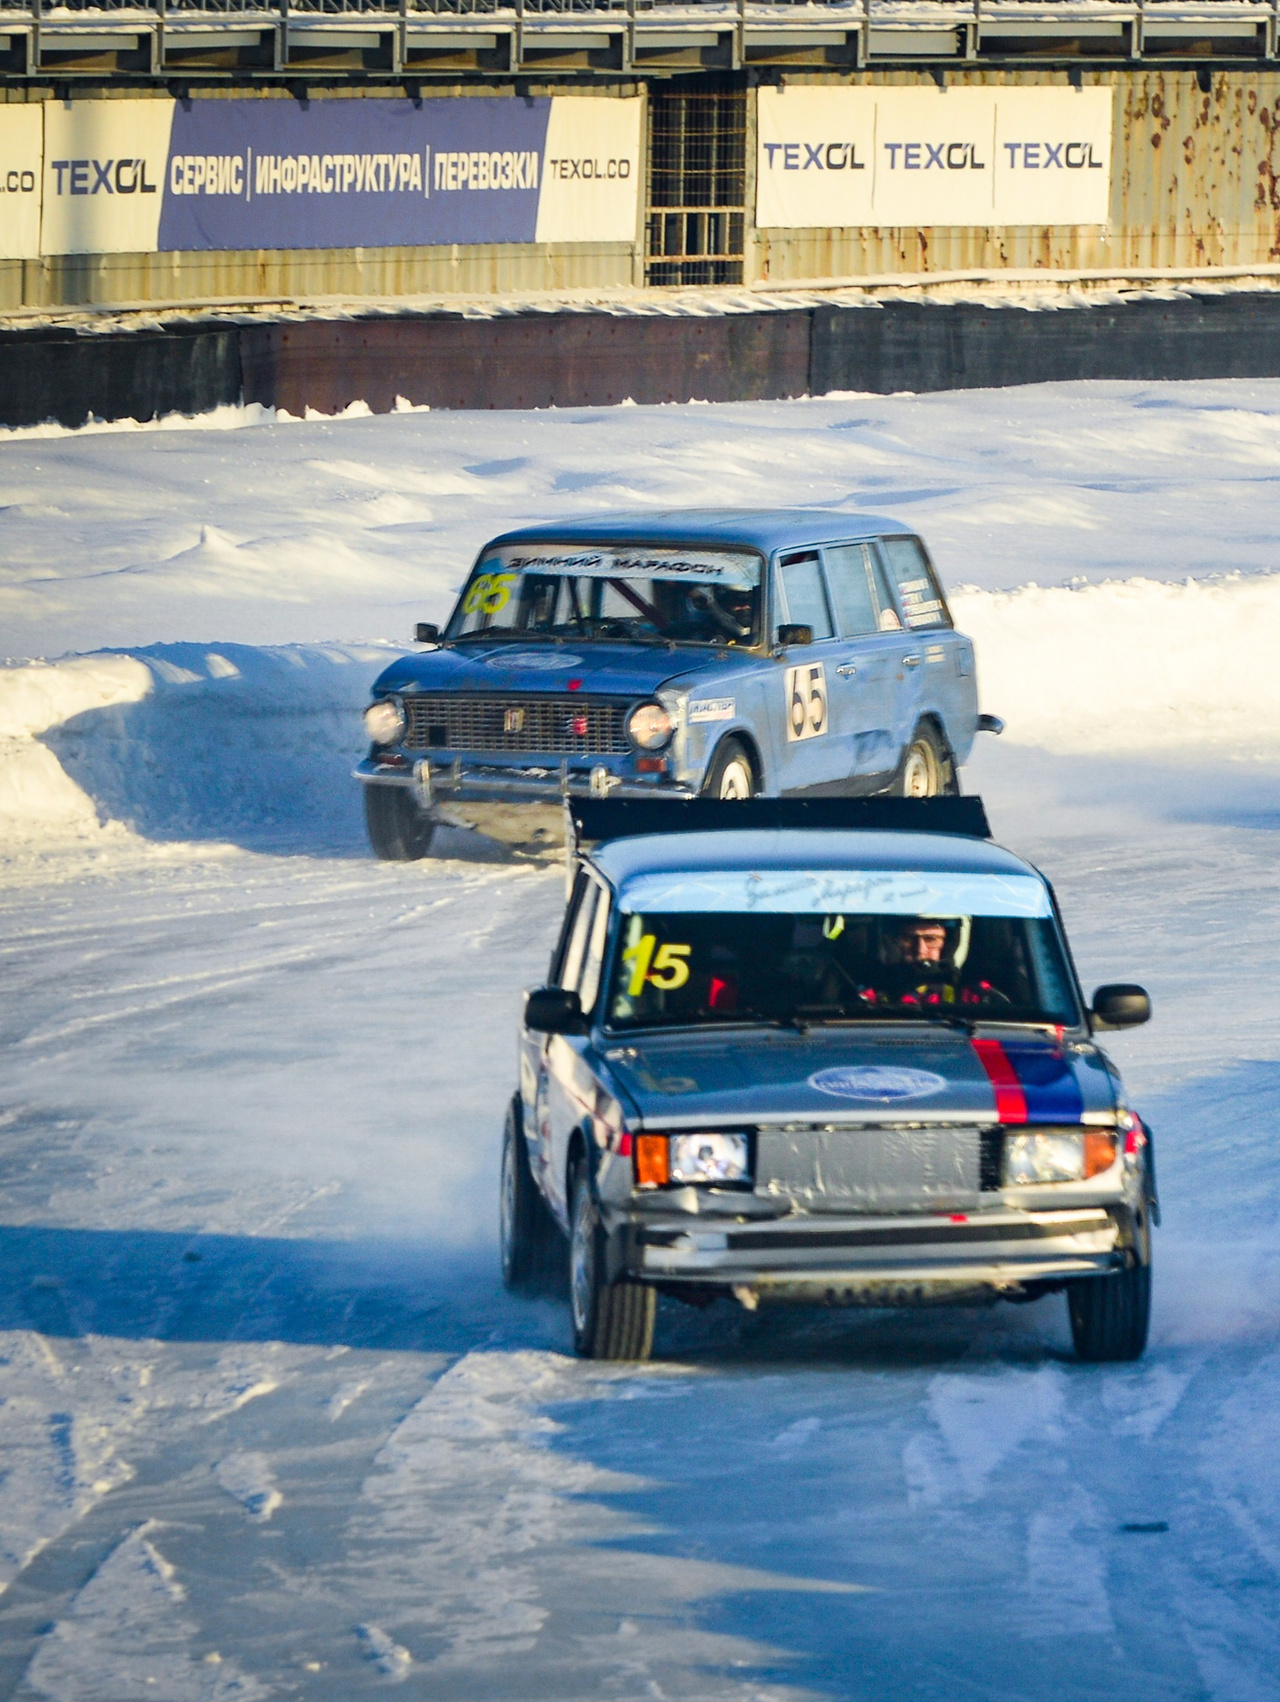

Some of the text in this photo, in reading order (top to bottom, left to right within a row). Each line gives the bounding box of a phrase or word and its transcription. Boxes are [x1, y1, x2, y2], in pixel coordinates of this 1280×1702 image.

[550, 159, 631, 179] TEXOL.CO
[764, 143, 864, 169] TEXOL
[884, 143, 985, 169] TEXOL
[1004, 142, 1103, 168] TEXOL
[51, 159, 157, 195] TEXOL
[170, 151, 539, 195] СЕРВИС ИНФРАСТРУКТУРА ПЕРЕВОЗКИ
[508, 555, 725, 576] ЗИМНИЙ МАРАФОН
[463, 573, 517, 614] 65
[791, 667, 825, 737] 65
[622, 934, 691, 996] 15
